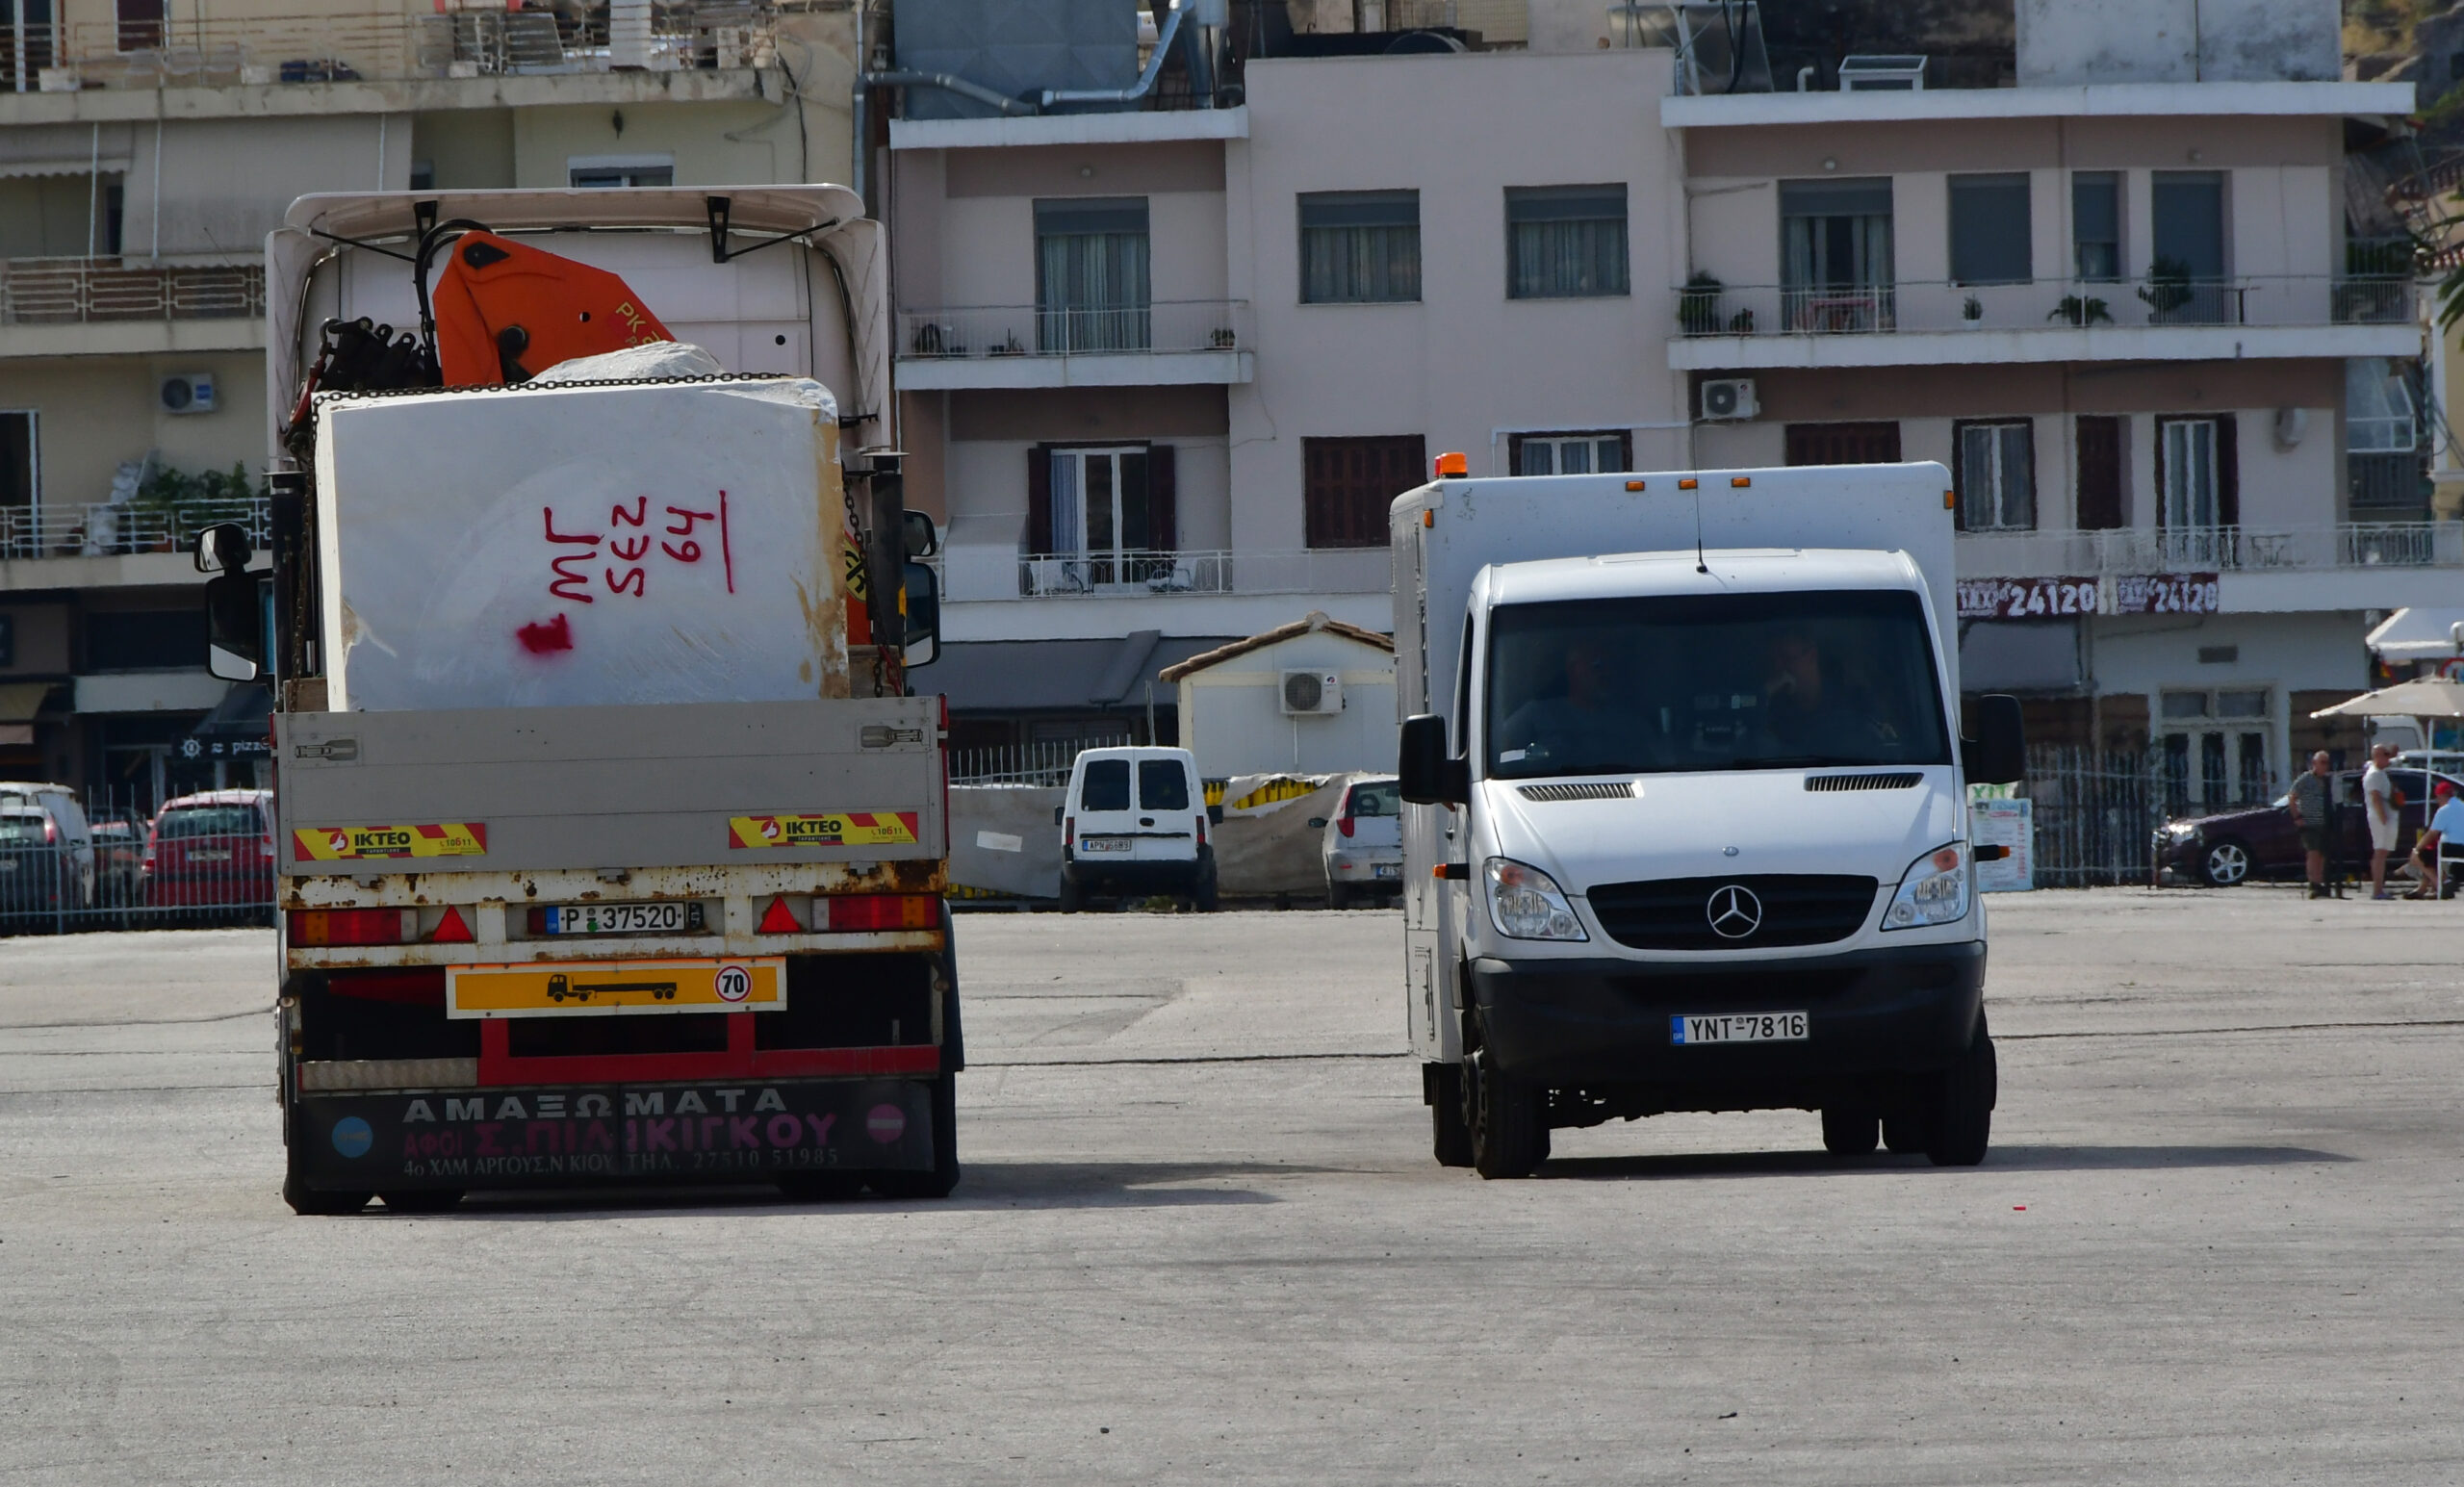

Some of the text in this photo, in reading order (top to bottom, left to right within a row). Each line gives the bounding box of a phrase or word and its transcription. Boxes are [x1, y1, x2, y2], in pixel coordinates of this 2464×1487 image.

[615, 301, 646, 334] PK
[661, 505, 715, 563] 64
[2007, 582, 2096, 616] 24120
[446, 837, 472, 847] 10611
[878, 825, 903, 835] 10611
[722, 974, 745, 993] 70
[402, 1088, 787, 1123] ΑΜΑΞΩΜΑΤΑ
[403, 1129, 463, 1157] ΑΦΟΙ
[693, 1149, 760, 1169] 27510
[772, 1147, 838, 1166] 51985
